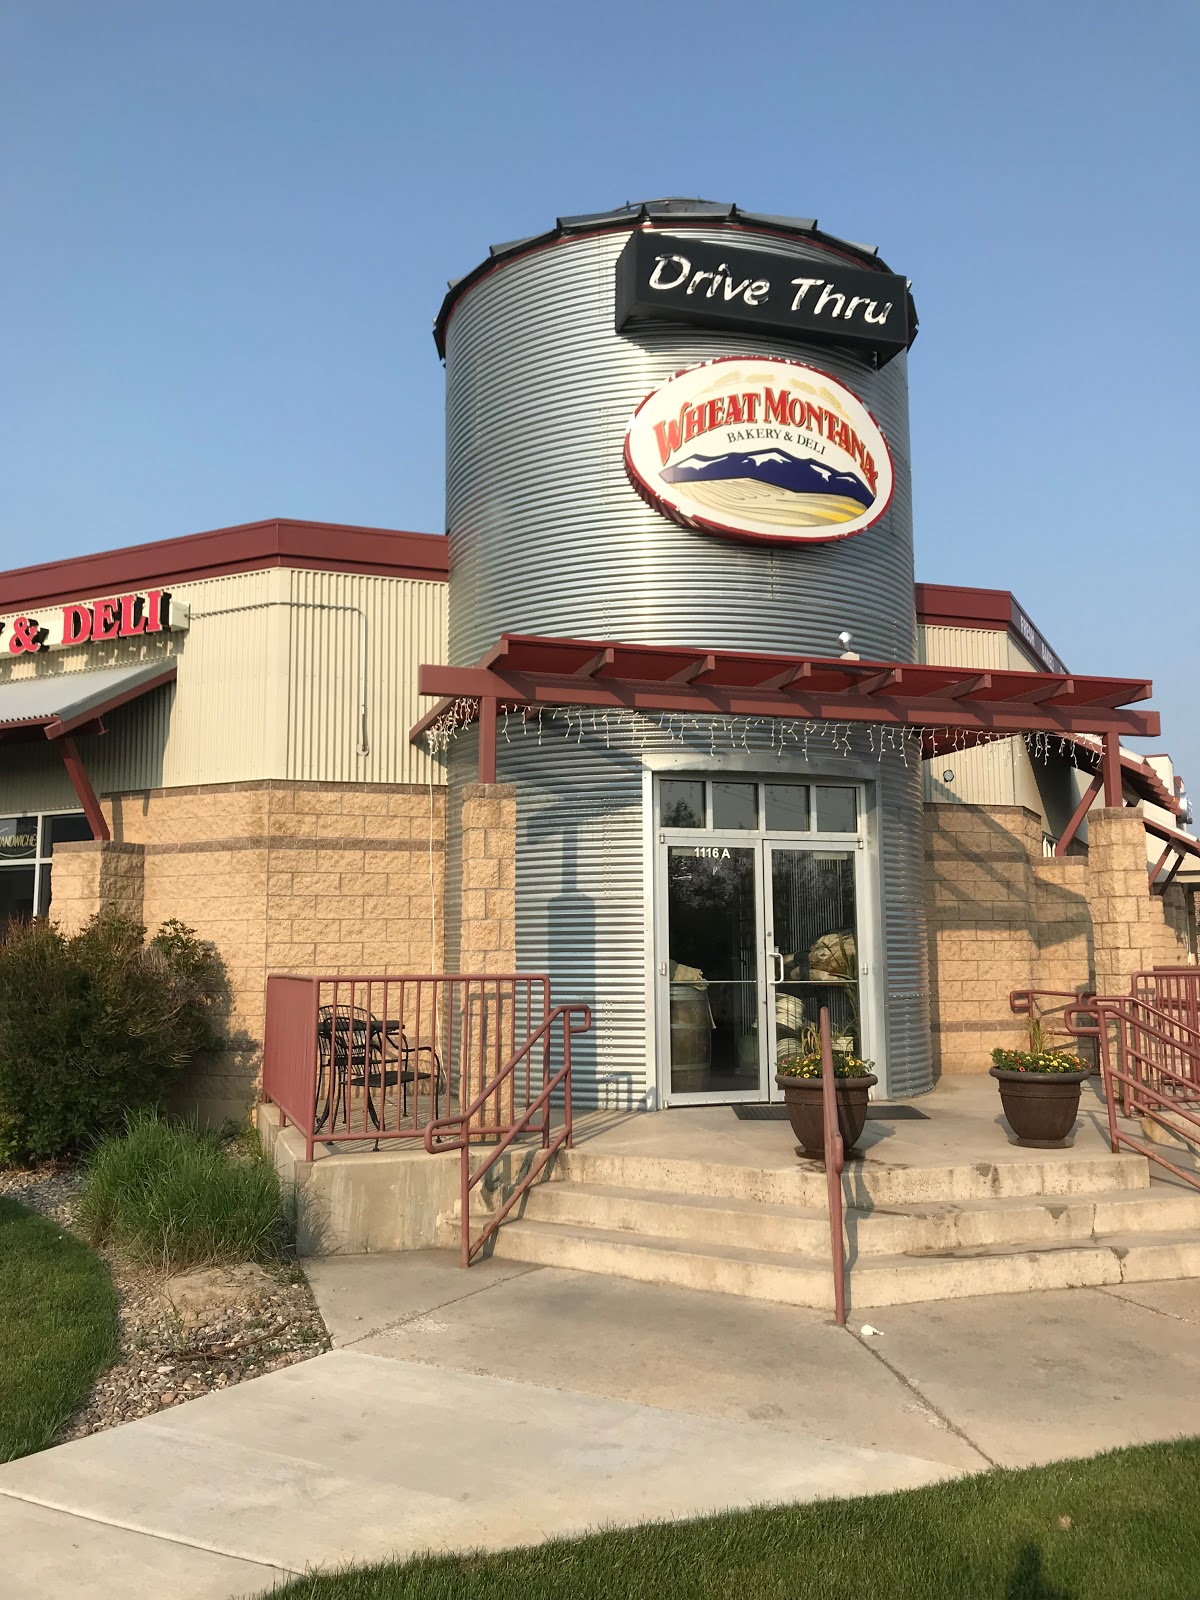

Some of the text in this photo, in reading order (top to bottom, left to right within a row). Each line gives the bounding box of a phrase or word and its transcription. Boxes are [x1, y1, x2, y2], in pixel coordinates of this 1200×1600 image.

[648, 253, 894, 325] Drive Thru
[727, 428, 826, 456] BAKERY & DELI
[9, 590, 162, 655] & DELI
[694, 847, 731, 859] 1116 A
